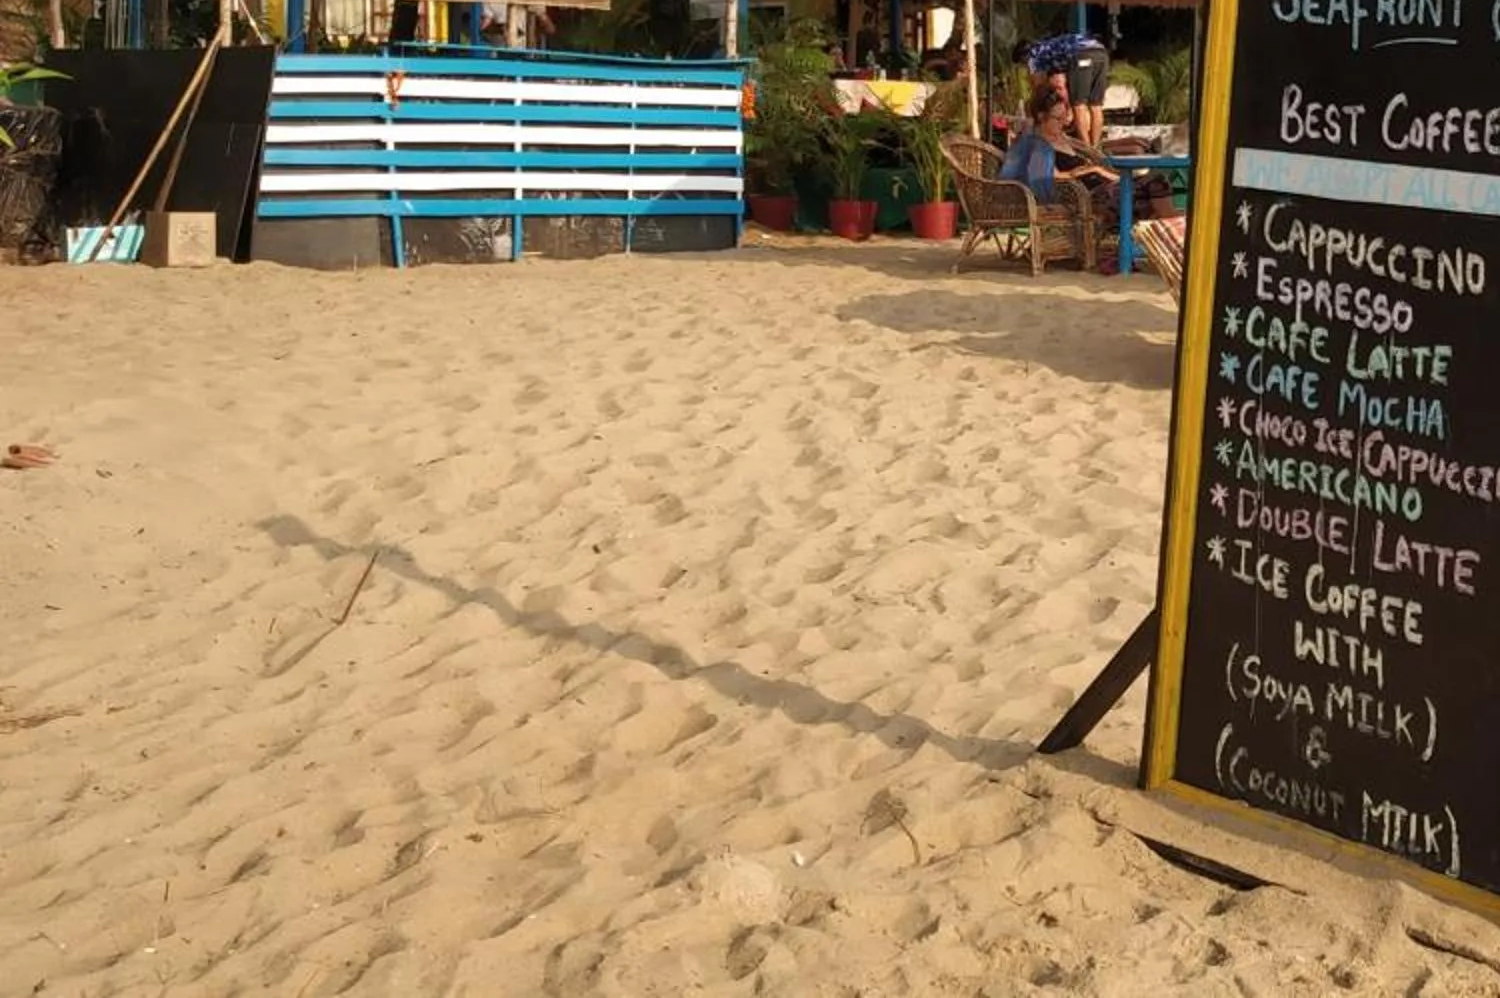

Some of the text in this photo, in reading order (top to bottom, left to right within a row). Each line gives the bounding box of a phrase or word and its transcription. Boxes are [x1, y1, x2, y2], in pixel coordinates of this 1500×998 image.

[1280, 84, 1365, 146] BEST
[1264, 202, 1485, 295] CAPPUCCINO
[1256, 257, 1413, 333] ESPRESSO
[1245, 306, 1452, 386] CAFE LATTE
[1240, 400, 1307, 449] CHOCO
[1314, 419, 1355, 459] ICE
[1245, 358, 1446, 440] CAFE MOCHA
[1237, 441, 1424, 522] AMERICANO
[1237, 489, 1480, 595] DOUBLE LATTE
[1232, 539, 1424, 645] ICE COFFEE
[1295, 622, 1384, 688] WITH
[1307, 725, 1331, 769] &
